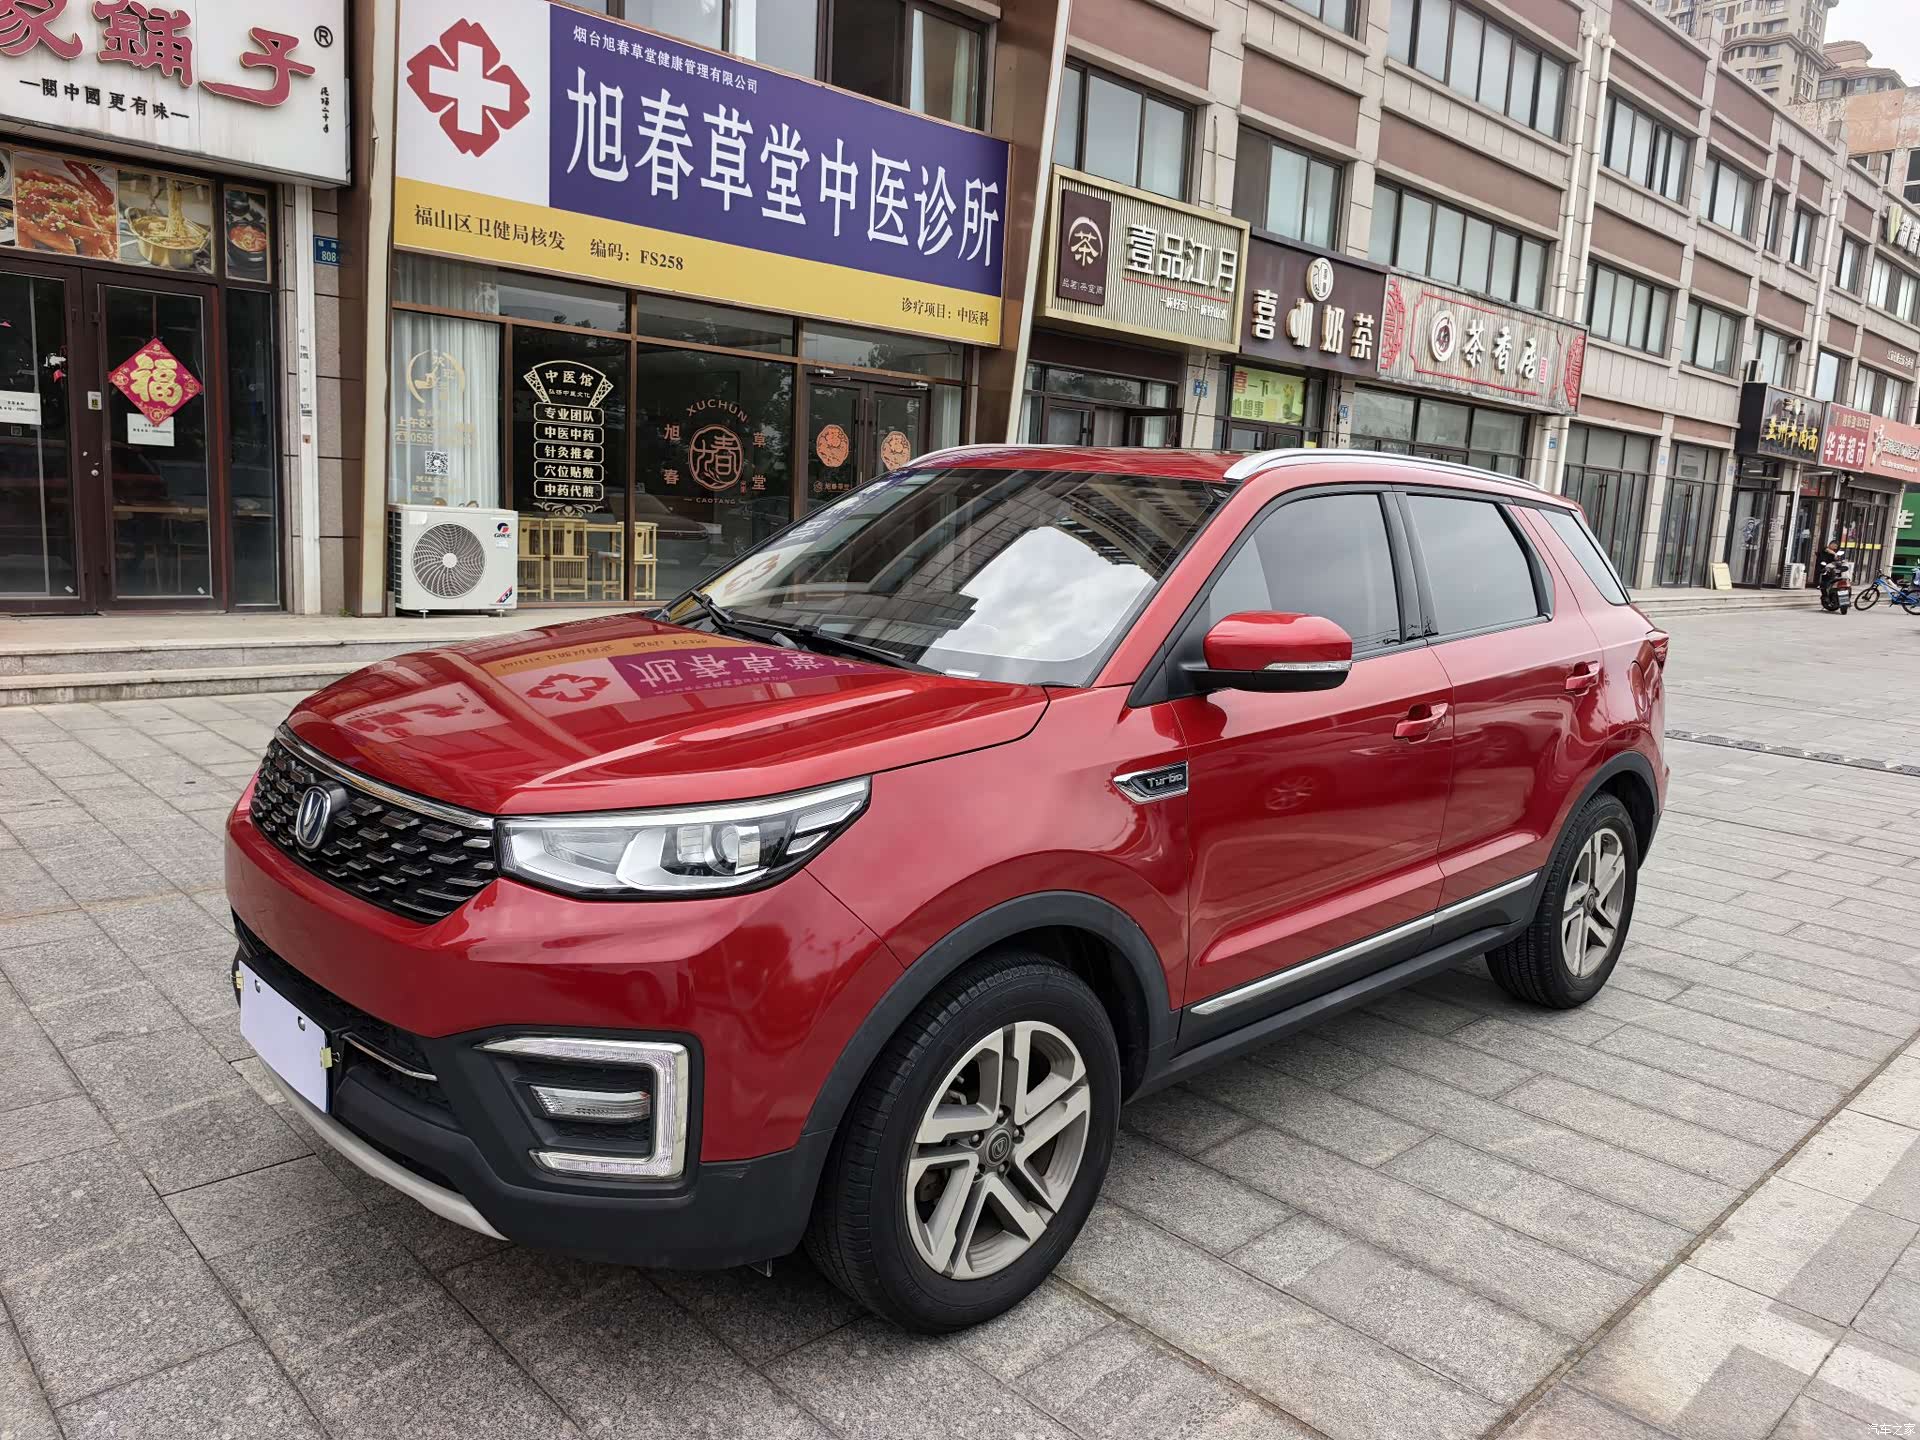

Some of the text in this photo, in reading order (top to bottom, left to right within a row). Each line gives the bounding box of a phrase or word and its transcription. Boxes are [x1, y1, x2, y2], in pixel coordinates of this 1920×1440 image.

[573, 25, 758, 94] 烟台旭春草堂健康管理有限公司
[566, 66, 1000, 269] 旭春草堂中医诊所
[414, 204, 566, 250] 福山区卫健局核发
[1070, 230, 1100, 267] 茶
[1124, 224, 1238, 293] 壹品江月
[130, 353, 184, 407] 福
[544, 369, 594, 387] 中医馆
[543, 406, 594, 423] 专业团队
[686, 398, 748, 423] XUCHUN
[543, 425, 594, 442] 中医中药
[543, 444, 594, 460] 针灸推拿
[543, 464, 594, 479] 穴位贴敷
[543, 483, 594, 498] 中药代煎
[695, 497, 736, 505] CAOTANG
